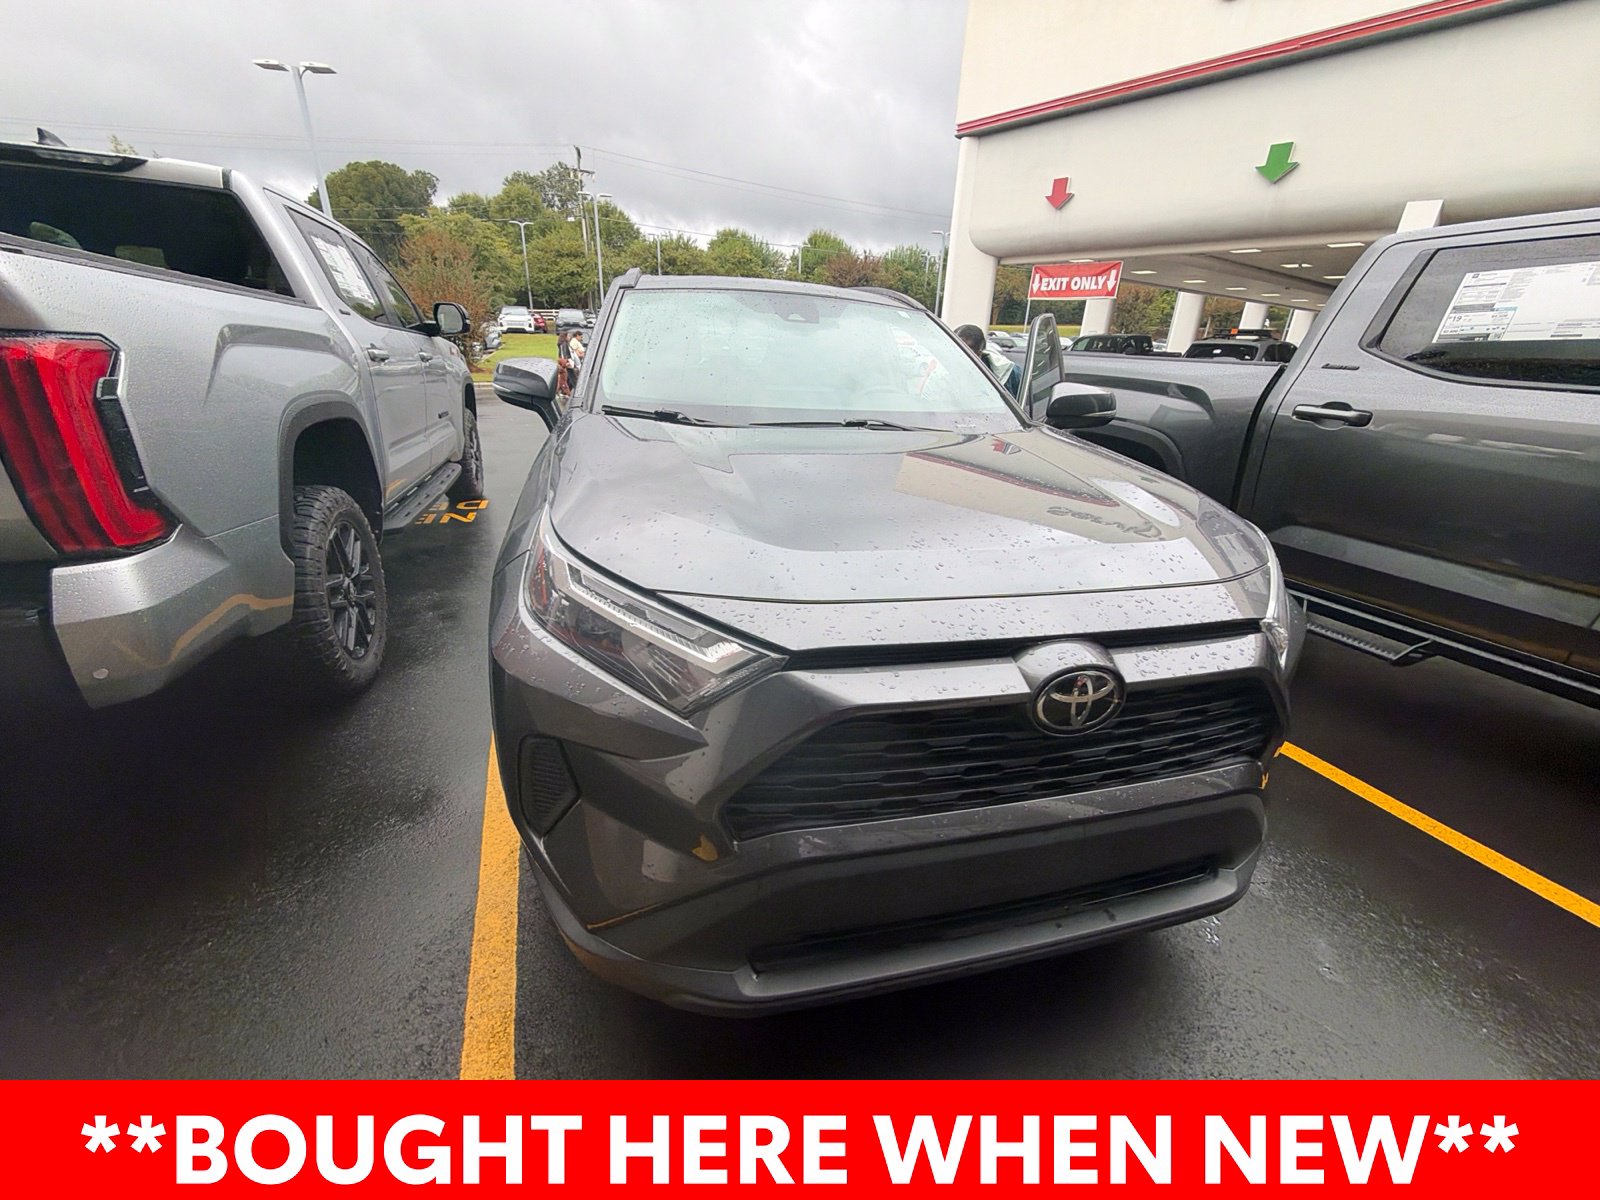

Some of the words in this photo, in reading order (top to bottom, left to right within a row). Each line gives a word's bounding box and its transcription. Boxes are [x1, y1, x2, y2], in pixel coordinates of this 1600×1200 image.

[1040, 277, 1069, 291] EXIT
[1070, 275, 1107, 291] ONLY
[415, 511, 477, 525] NE
